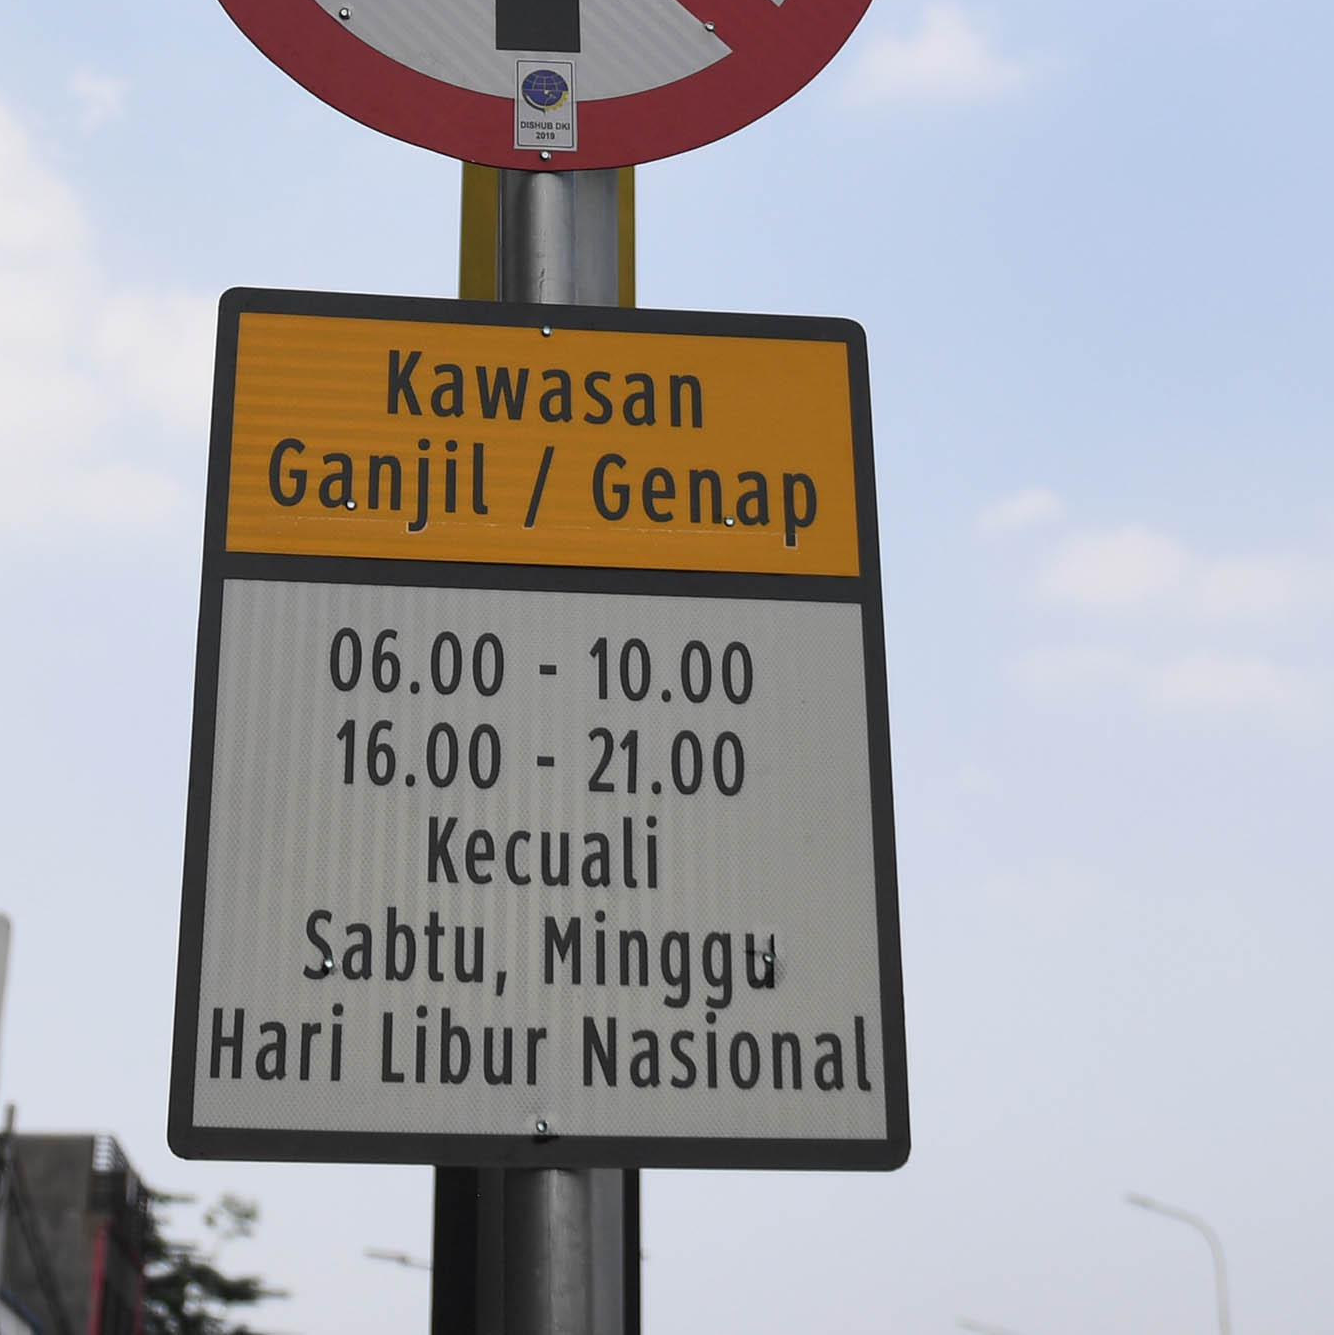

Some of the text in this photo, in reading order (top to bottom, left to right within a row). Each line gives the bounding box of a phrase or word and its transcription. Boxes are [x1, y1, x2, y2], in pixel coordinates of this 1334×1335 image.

[520, 121, 571, 131] DISHUB DKI
[535, 131, 556, 140] 2019
[385, 348, 704, 429] Kawasan
[267, 437, 819, 548] Ganjil / Genap
[328, 626, 755, 706] 06.00 - 10.00
[335, 718, 747, 797] 16.00 - 21.00
[426, 814, 660, 890] Kecuali
[301, 904, 779, 1010] Sabtu, Minggu
[208, 1001, 874, 1094] Hari Libur Nasional
